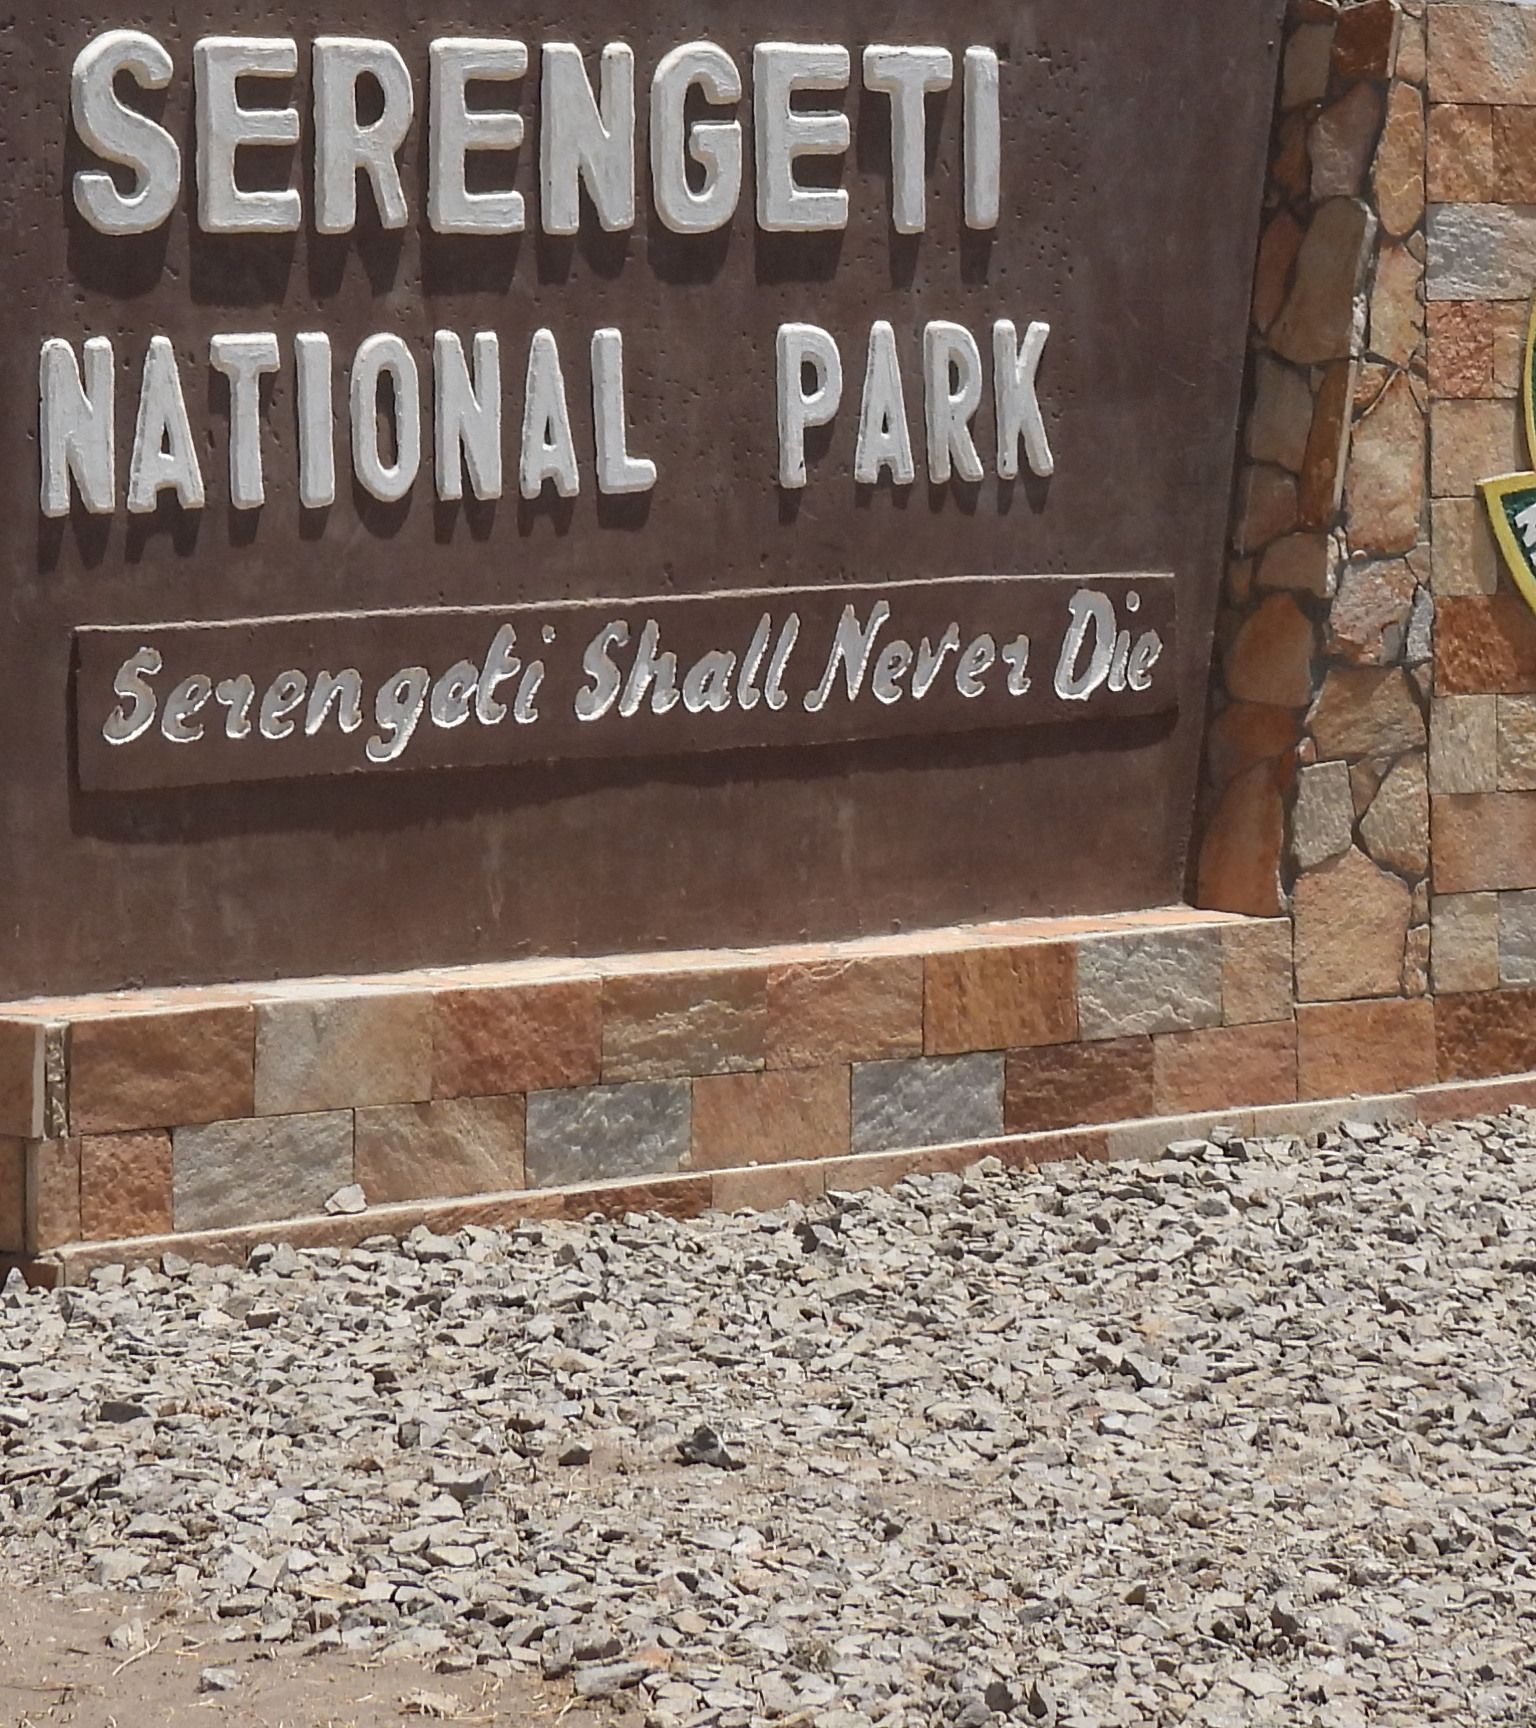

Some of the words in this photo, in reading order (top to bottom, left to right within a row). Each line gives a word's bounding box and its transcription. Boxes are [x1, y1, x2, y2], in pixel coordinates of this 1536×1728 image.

[71, 29, 1001, 235] SERENGETI
[39, 327, 657, 516] NATIONAL
[776, 319, 1054, 488] PARK
[102, 621, 556, 763] Serengeti
[575, 610, 800, 722] Shall
[803, 598, 1032, 714] Never
[1053, 588, 1165, 702] Die
